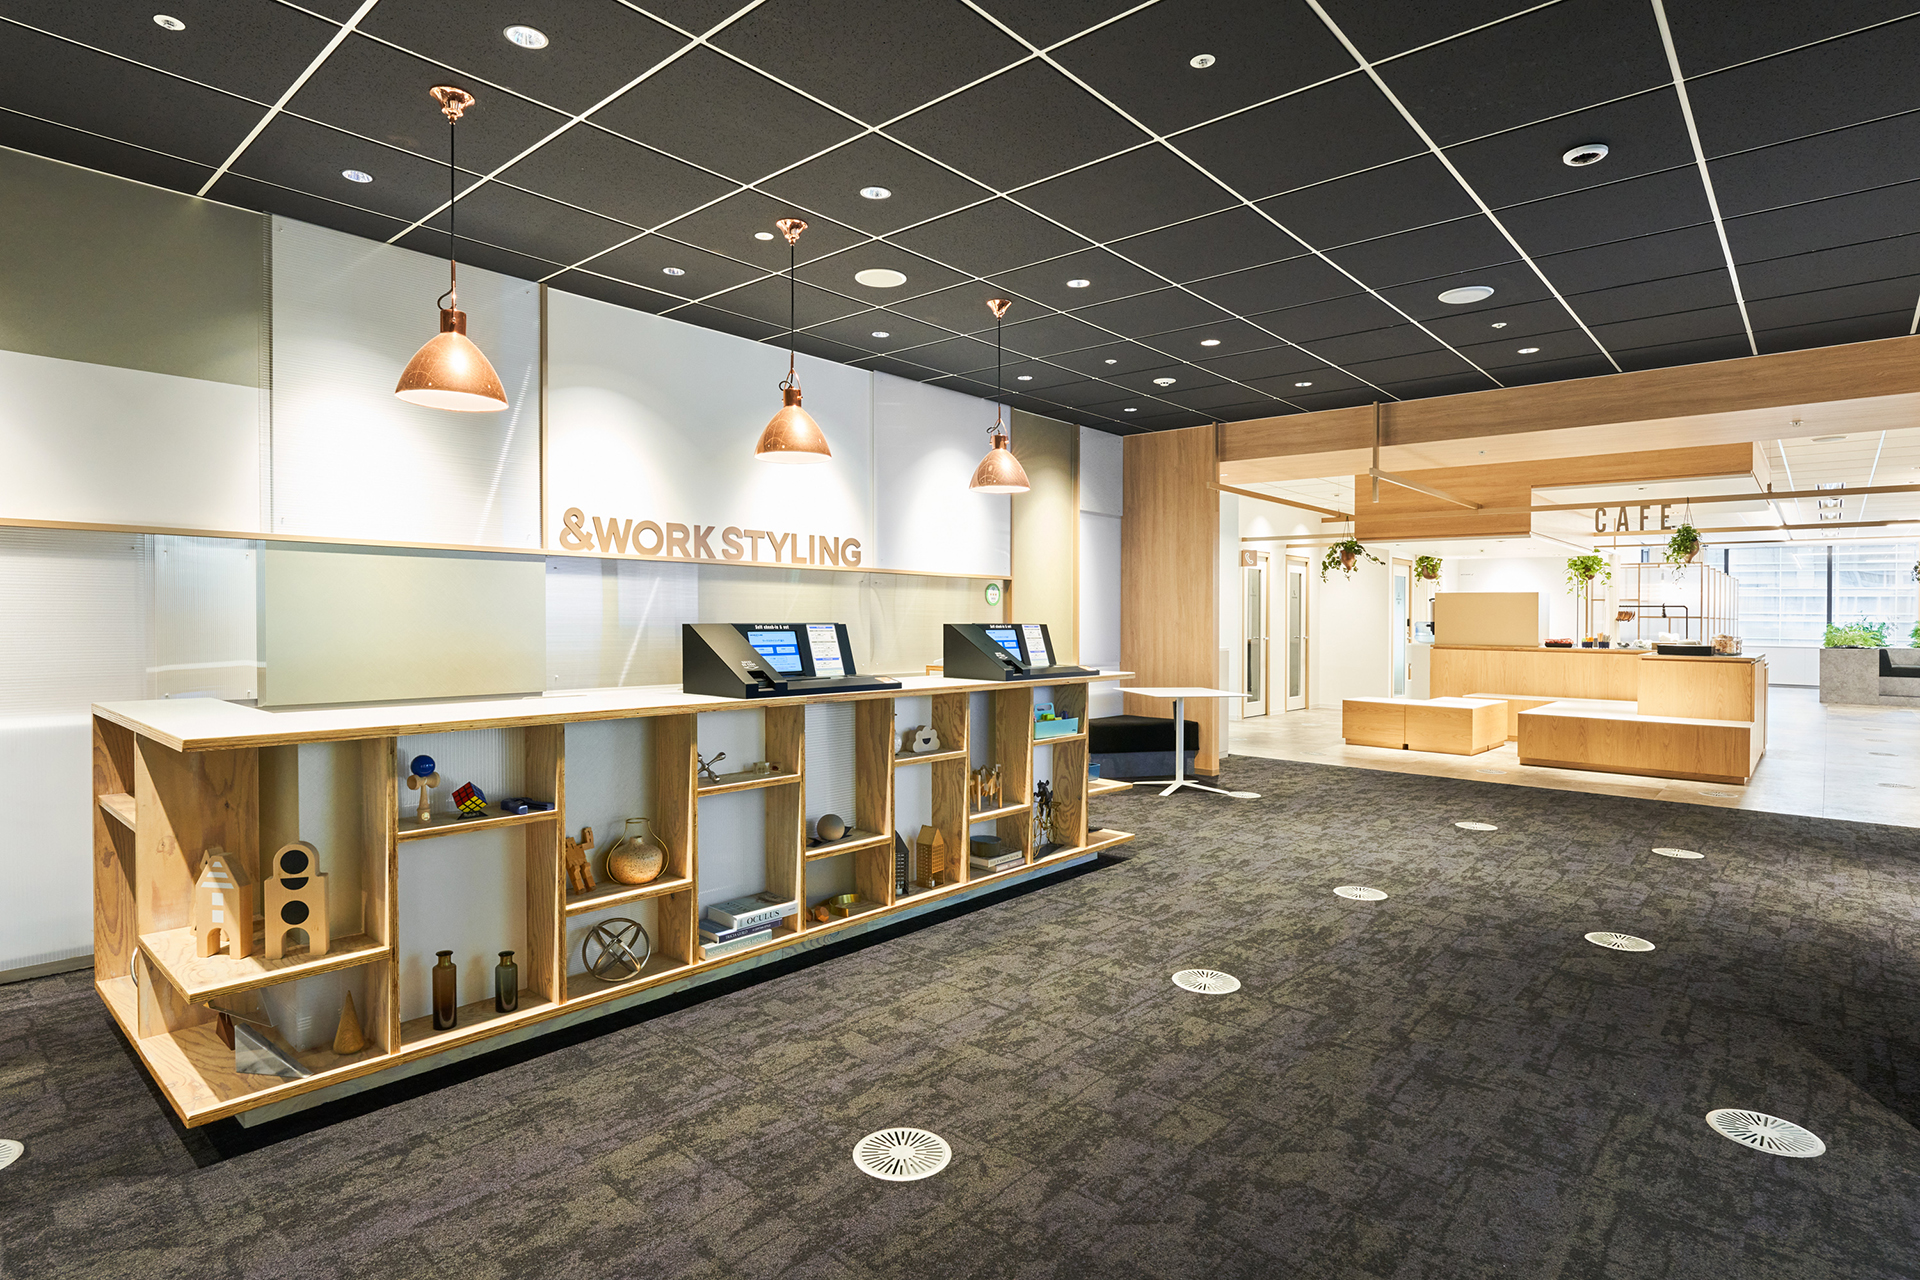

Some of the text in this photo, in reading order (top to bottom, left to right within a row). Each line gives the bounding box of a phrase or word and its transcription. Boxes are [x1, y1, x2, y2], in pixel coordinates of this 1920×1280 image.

[1595, 504, 1672, 533] CAFE
[746, 910, 780, 925] OCULUS
[708, 935, 769, 956] NORDIC INTERIORS HOMES
